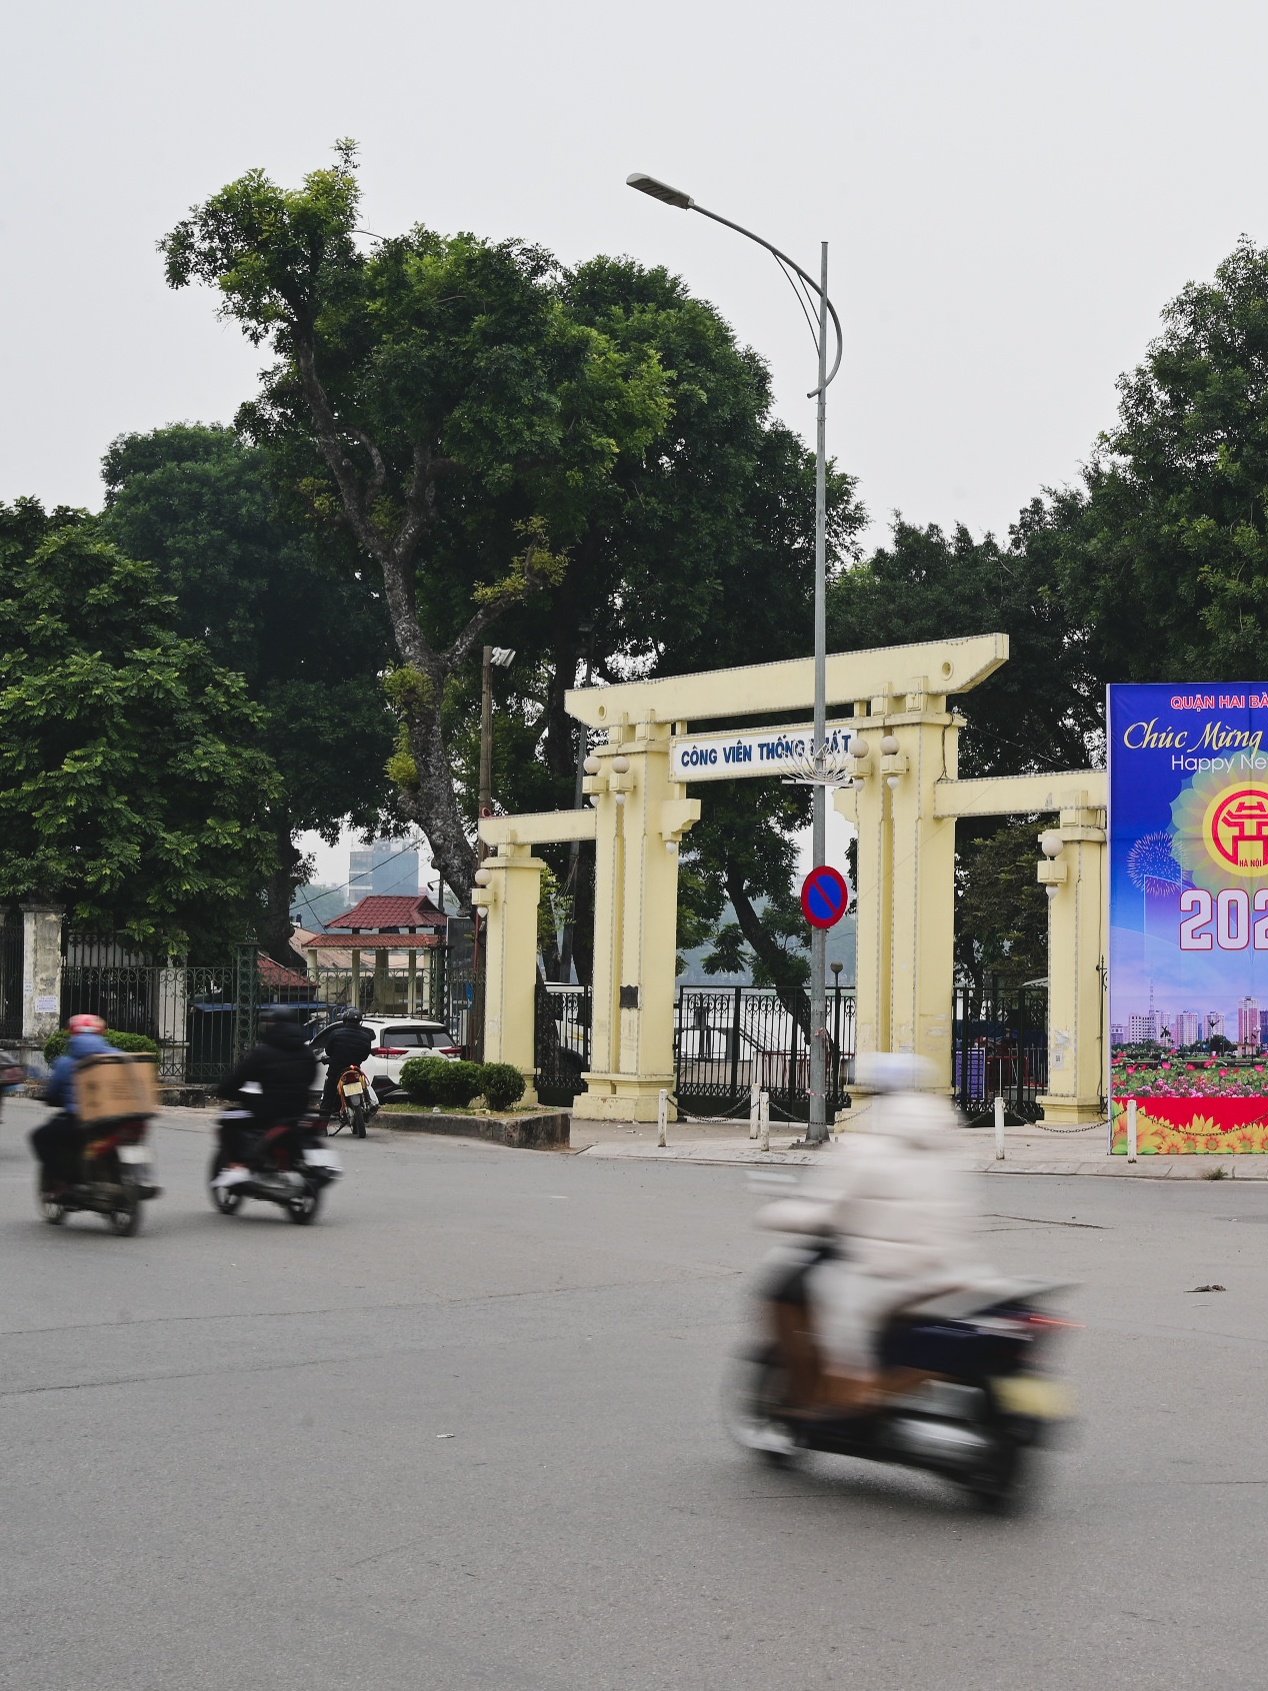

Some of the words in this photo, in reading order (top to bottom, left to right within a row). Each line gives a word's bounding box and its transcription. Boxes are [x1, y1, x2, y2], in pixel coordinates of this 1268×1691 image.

[1170, 694, 1215, 712] QUẬN
[1219, 694, 1246, 709] HAI
[1123, 717, 1188, 750] Chúc
[1187, 721, 1264, 756] Mừng
[681, 744, 718, 768] CÔNG
[722, 739, 753, 764] VIÊN
[757, 734, 806, 761] THỐNG
[1171, 754, 1235, 774] Happy
[1239, 858, 1249, 867] HÀ
[1250, 858, 1262, 869] NỘI
